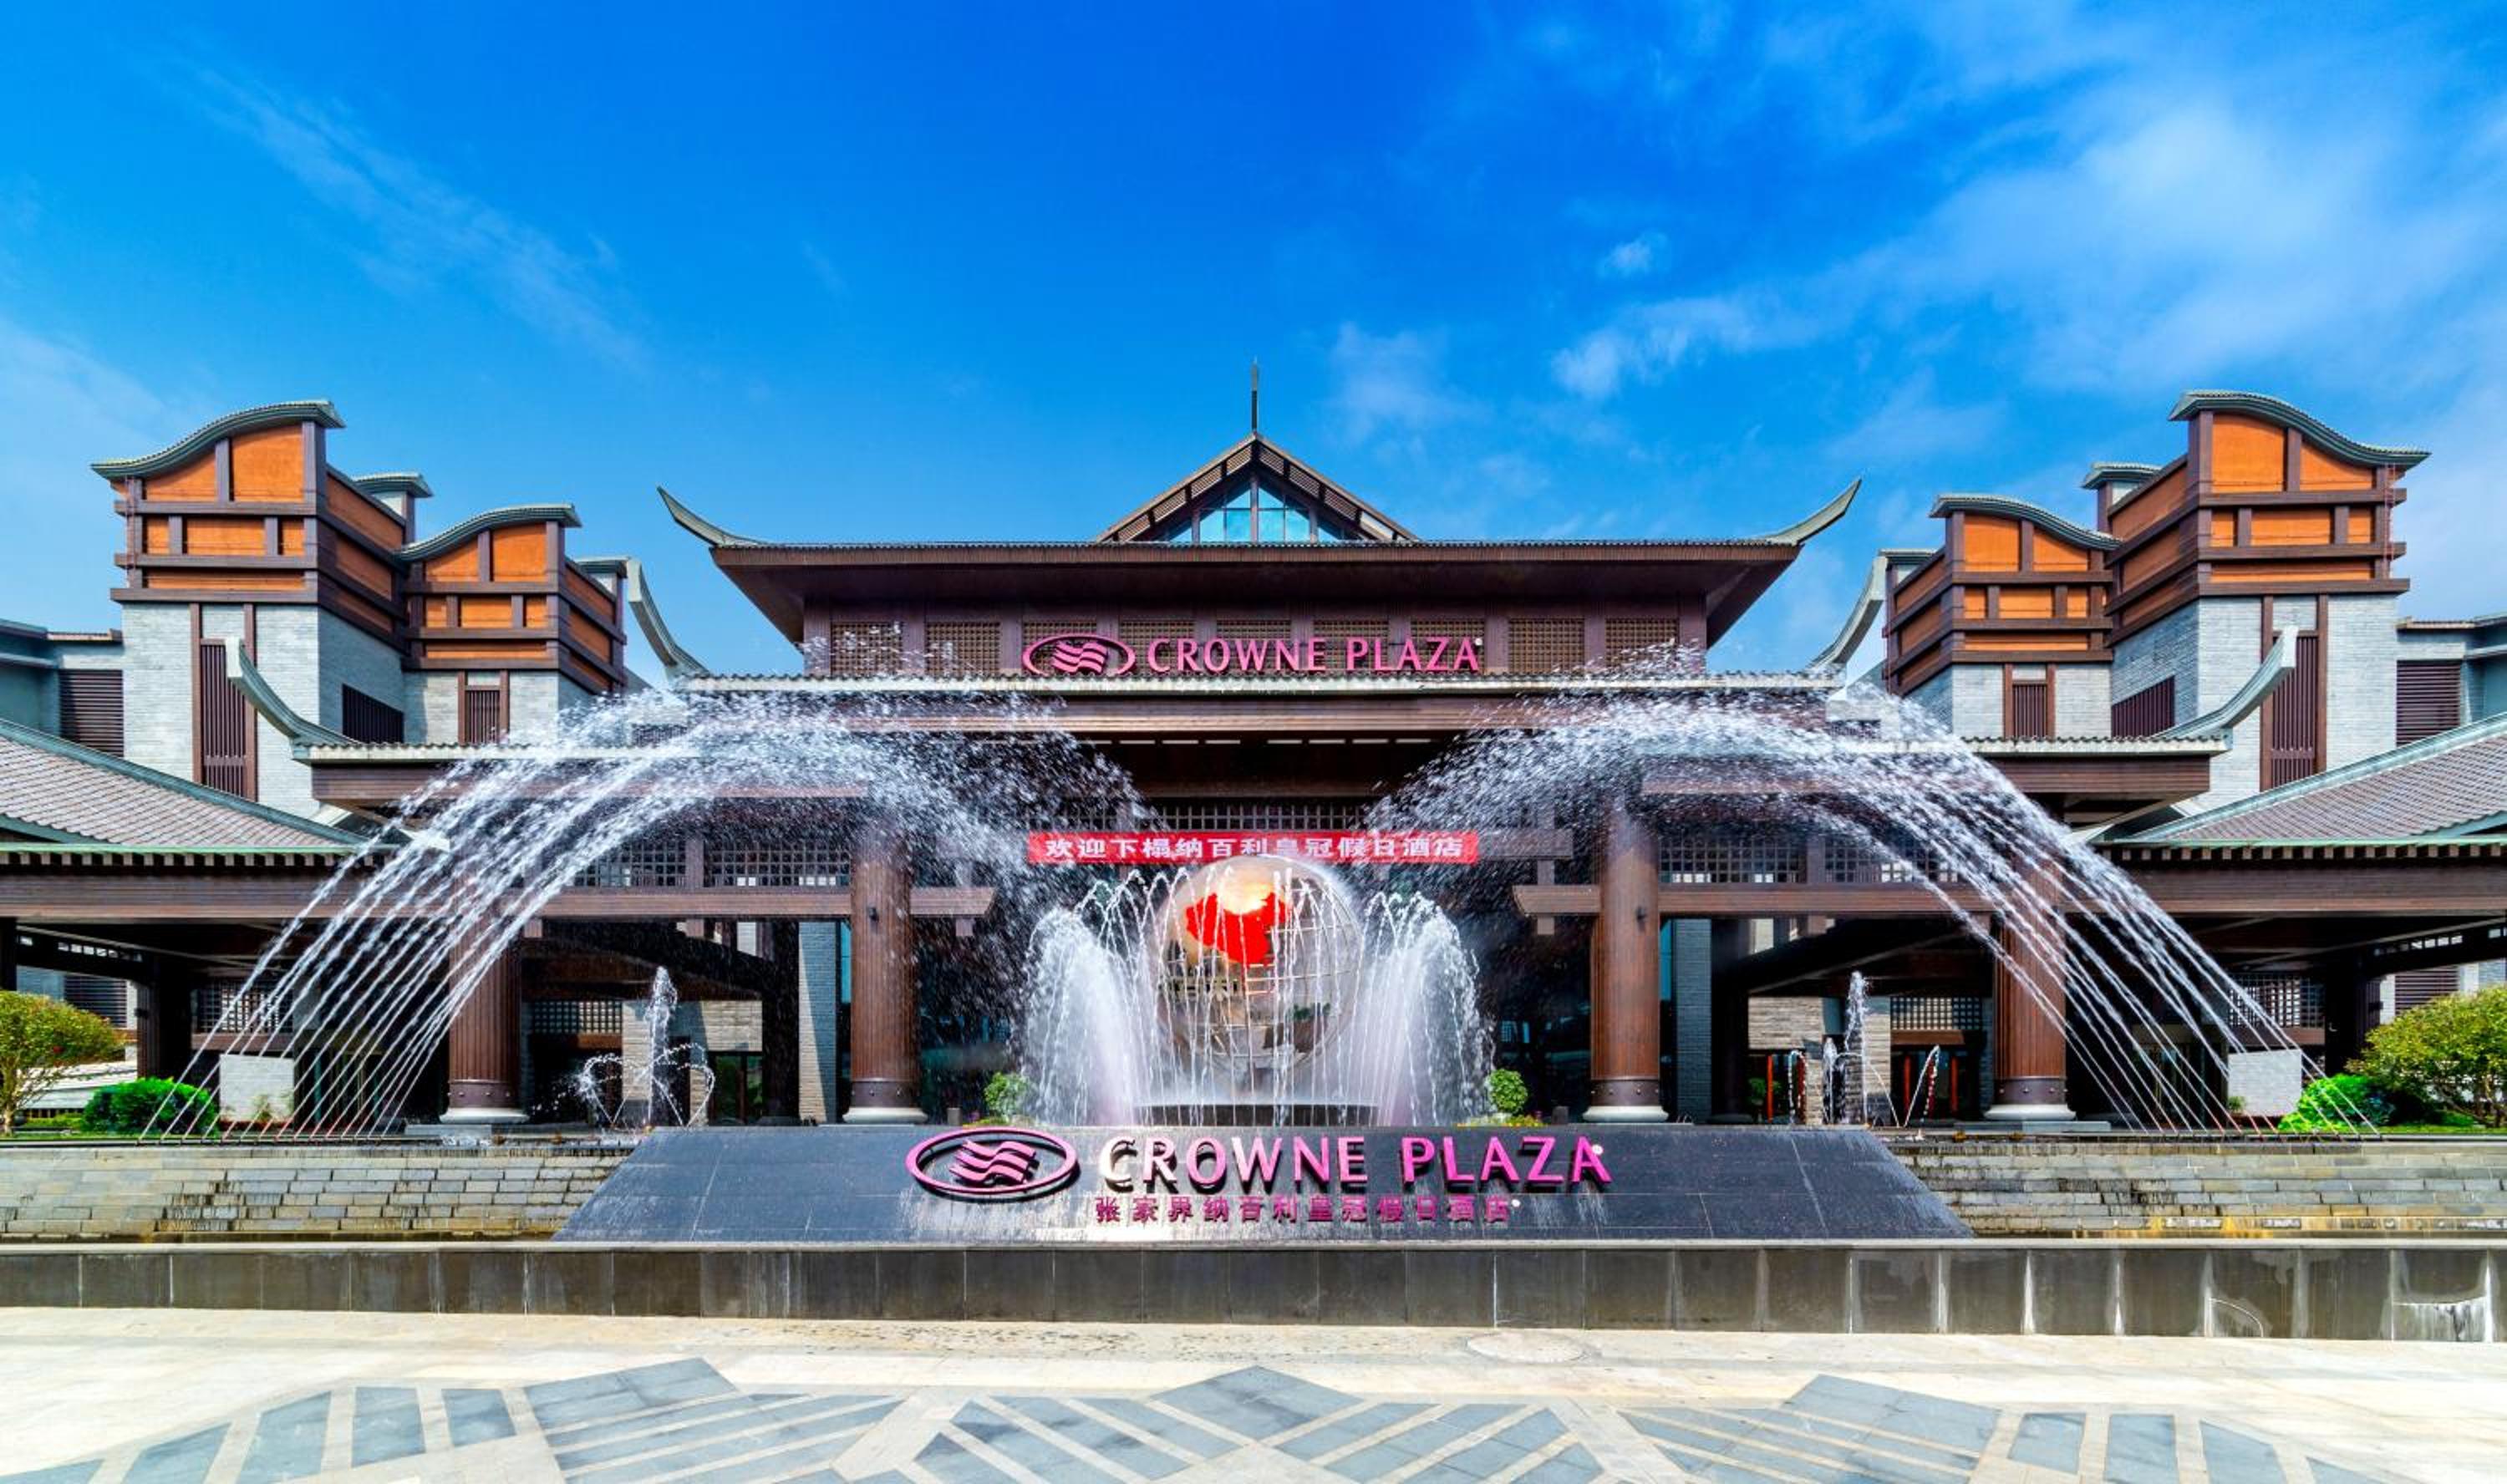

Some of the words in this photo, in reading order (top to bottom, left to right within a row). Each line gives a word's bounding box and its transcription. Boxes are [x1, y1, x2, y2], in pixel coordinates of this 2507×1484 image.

[1147, 638, 1326, 671] CROWNE
[1346, 638, 1479, 671] PLAZA
[1099, 1136, 1367, 1183] CROWNE
[1401, 1136, 1611, 1183] PLAZA
[1096, 1196, 1509, 1222] 张家界纳百利皇冠假日酒店
